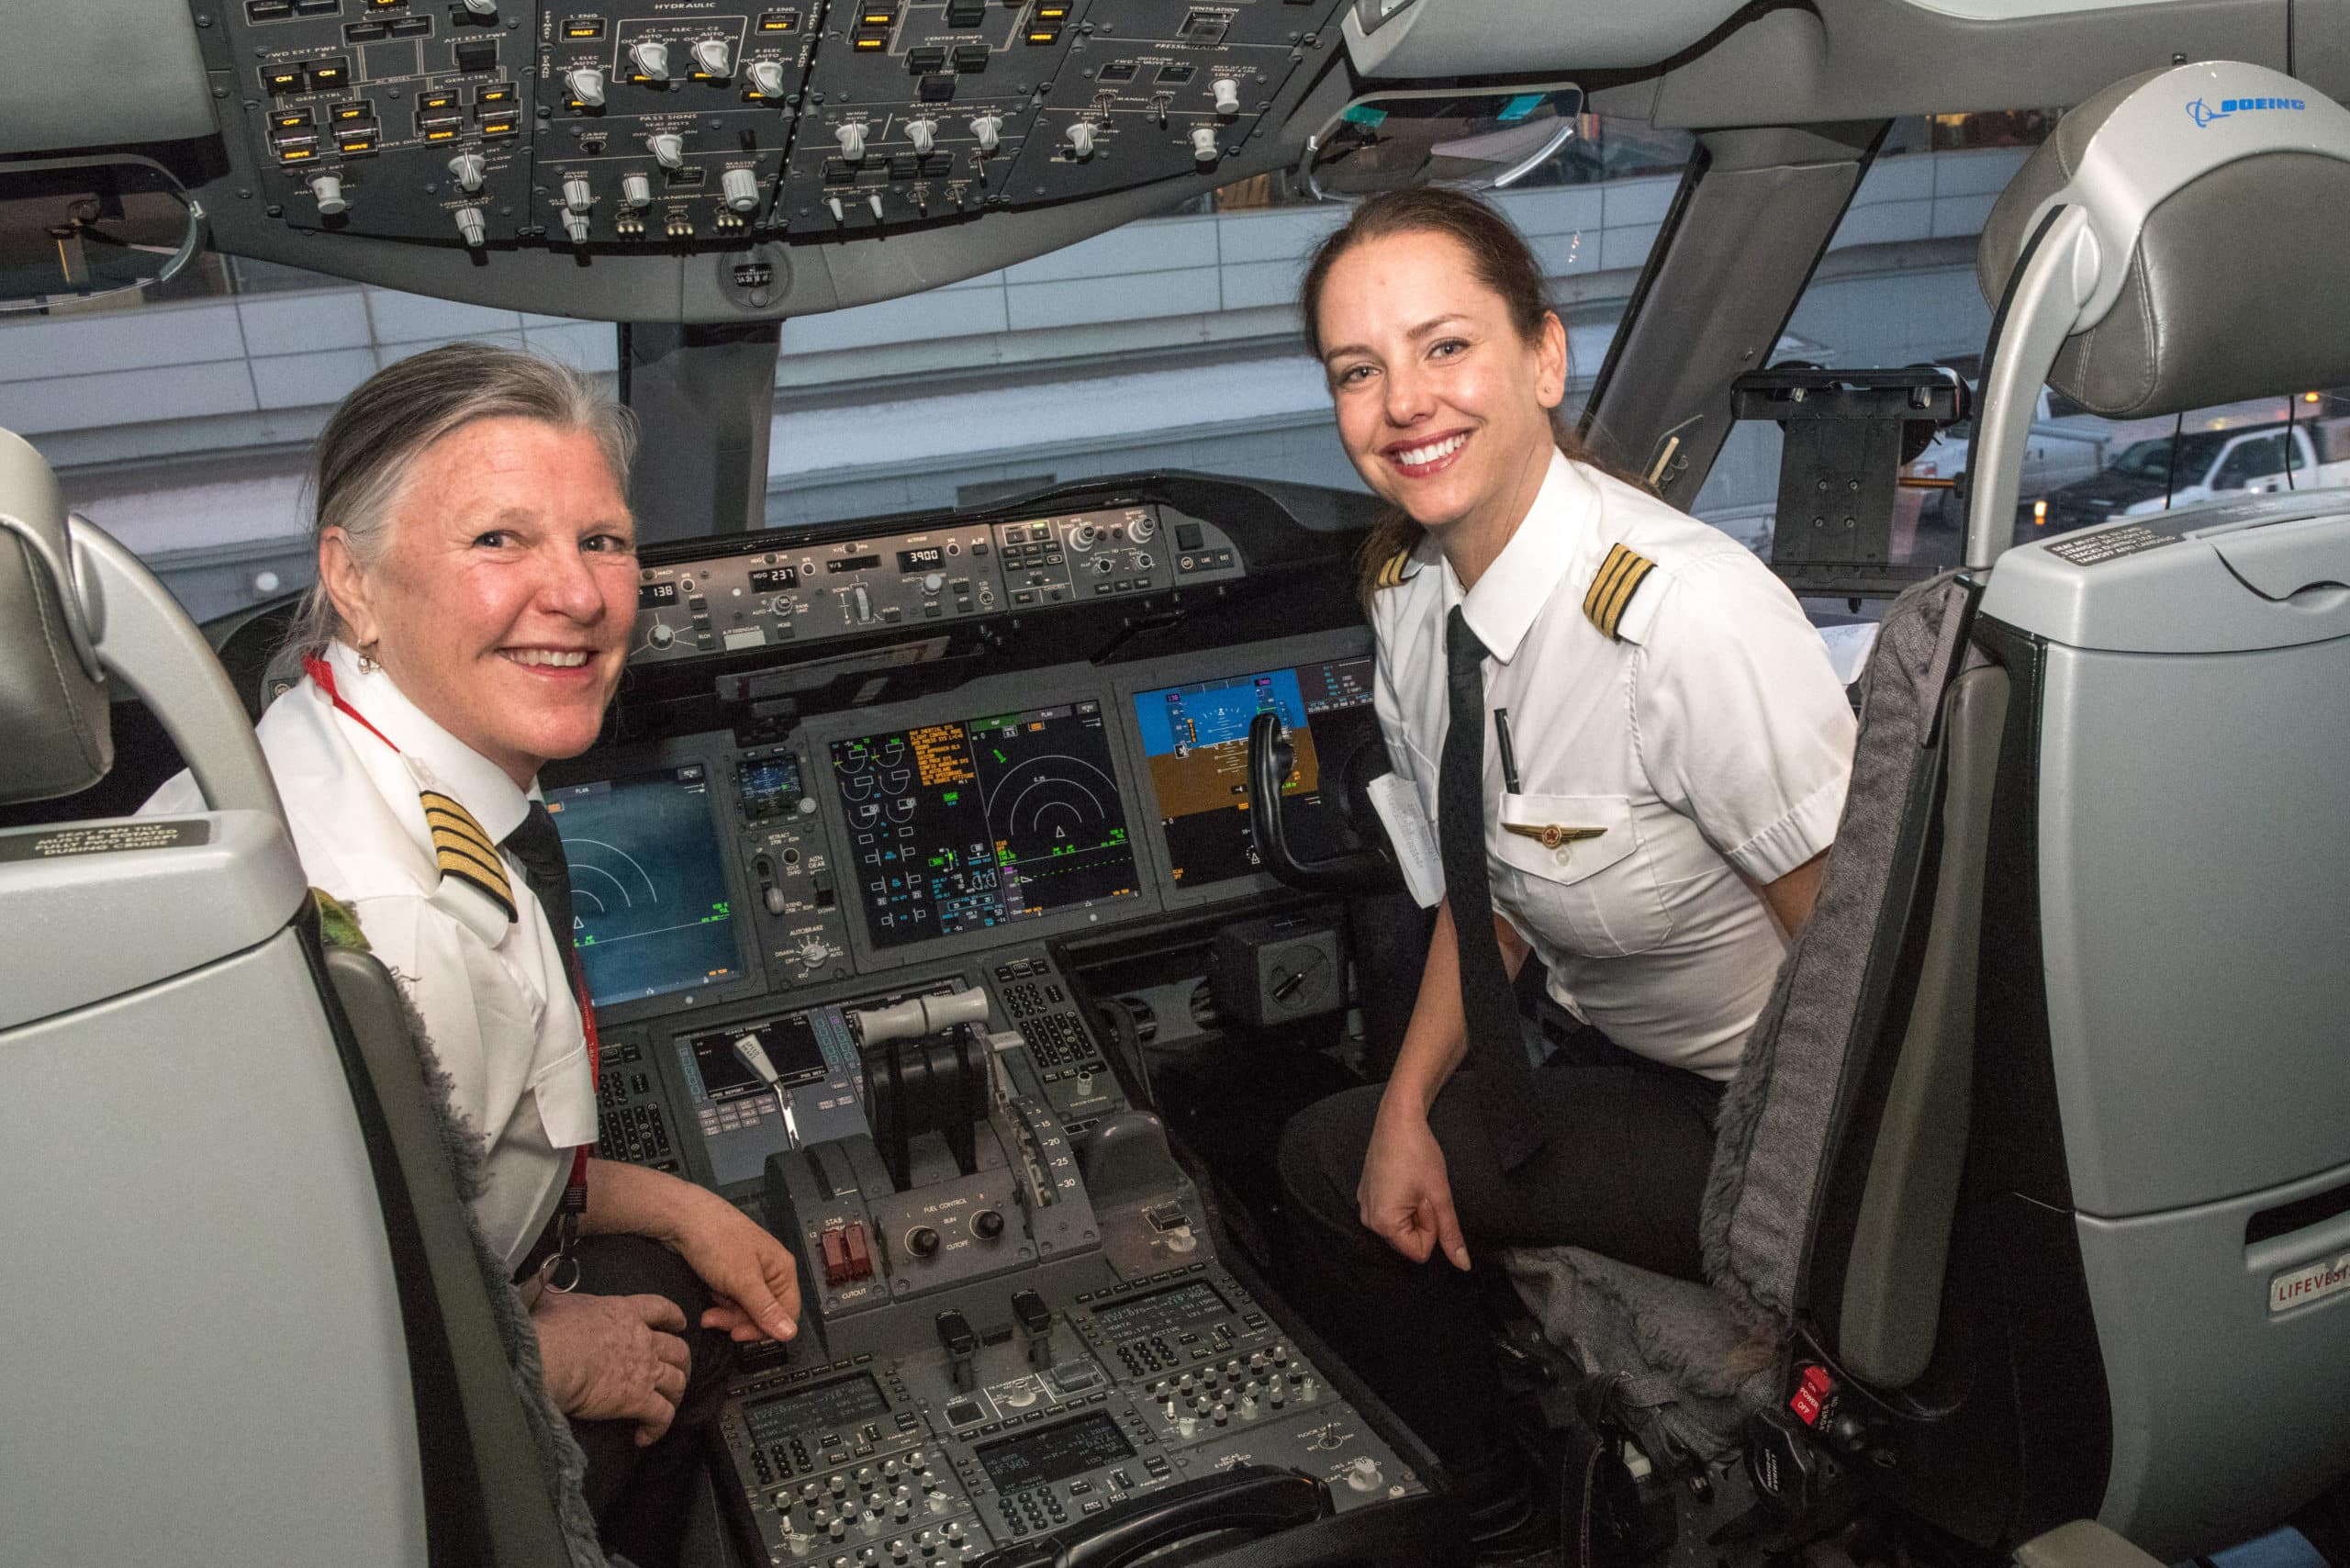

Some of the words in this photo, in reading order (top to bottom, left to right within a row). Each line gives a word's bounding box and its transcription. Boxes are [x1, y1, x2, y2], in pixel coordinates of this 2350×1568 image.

[655, 2, 716, 10] HYDRAULIC
[2221, 98, 2306, 112] BOEING
[282, 118, 301, 126] OFF
[911, 551, 938, 563] 3900
[771, 569, 793, 581] 237
[654, 586, 673, 598] 138
[37, 836, 81, 846] MUST
[109, 829, 177, 838] ROTATED
[57, 830, 92, 838] SEAT
[35, 842, 77, 851] FULLY
[124, 834, 179, 842] EXCEPT
[44, 845, 109, 855] DURING
[113, 840, 169, 848] CRUISE
[789, 924, 823, 936] AUTOBRAKE
[1041, 1120, 1051, 1128] 15
[1048, 1137, 1060, 1147] 20
[1056, 1157, 1069, 1166] 25
[1063, 1178, 1076, 1188] 30
[923, 1204, 938, 1213] FUEL
[939, 1198, 968, 1210] CONTROL
[946, 1240, 969, 1250] CUTOFF
[842, 1289, 867, 1299] CUTOUT
[1800, 1387, 1819, 1409] POWER
[1797, 1401, 1810, 1414] OFF
